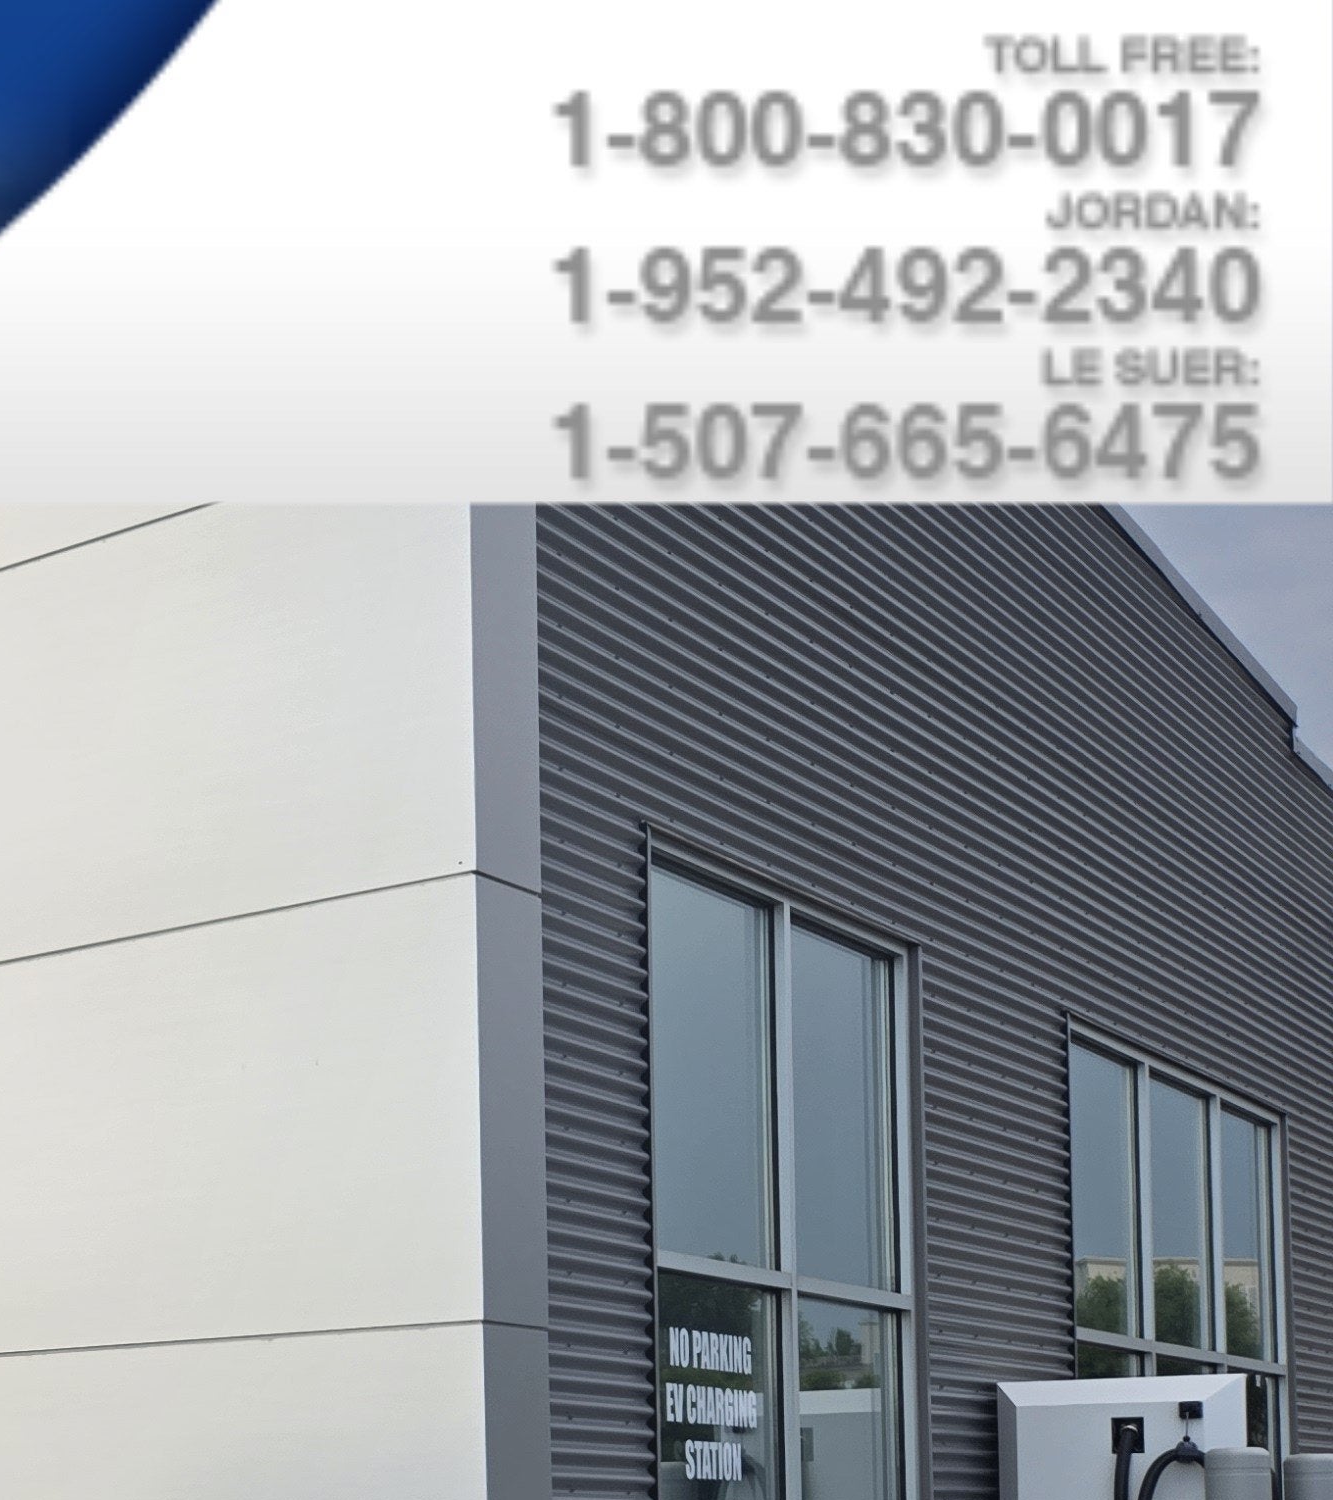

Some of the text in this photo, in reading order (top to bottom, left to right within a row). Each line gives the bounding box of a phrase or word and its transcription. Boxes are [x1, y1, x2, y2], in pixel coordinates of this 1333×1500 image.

[669, 1326, 753, 1375] NO PARKING
[665, 1382, 758, 1429] EV CHARGING
[685, 1438, 743, 1482] STATION
